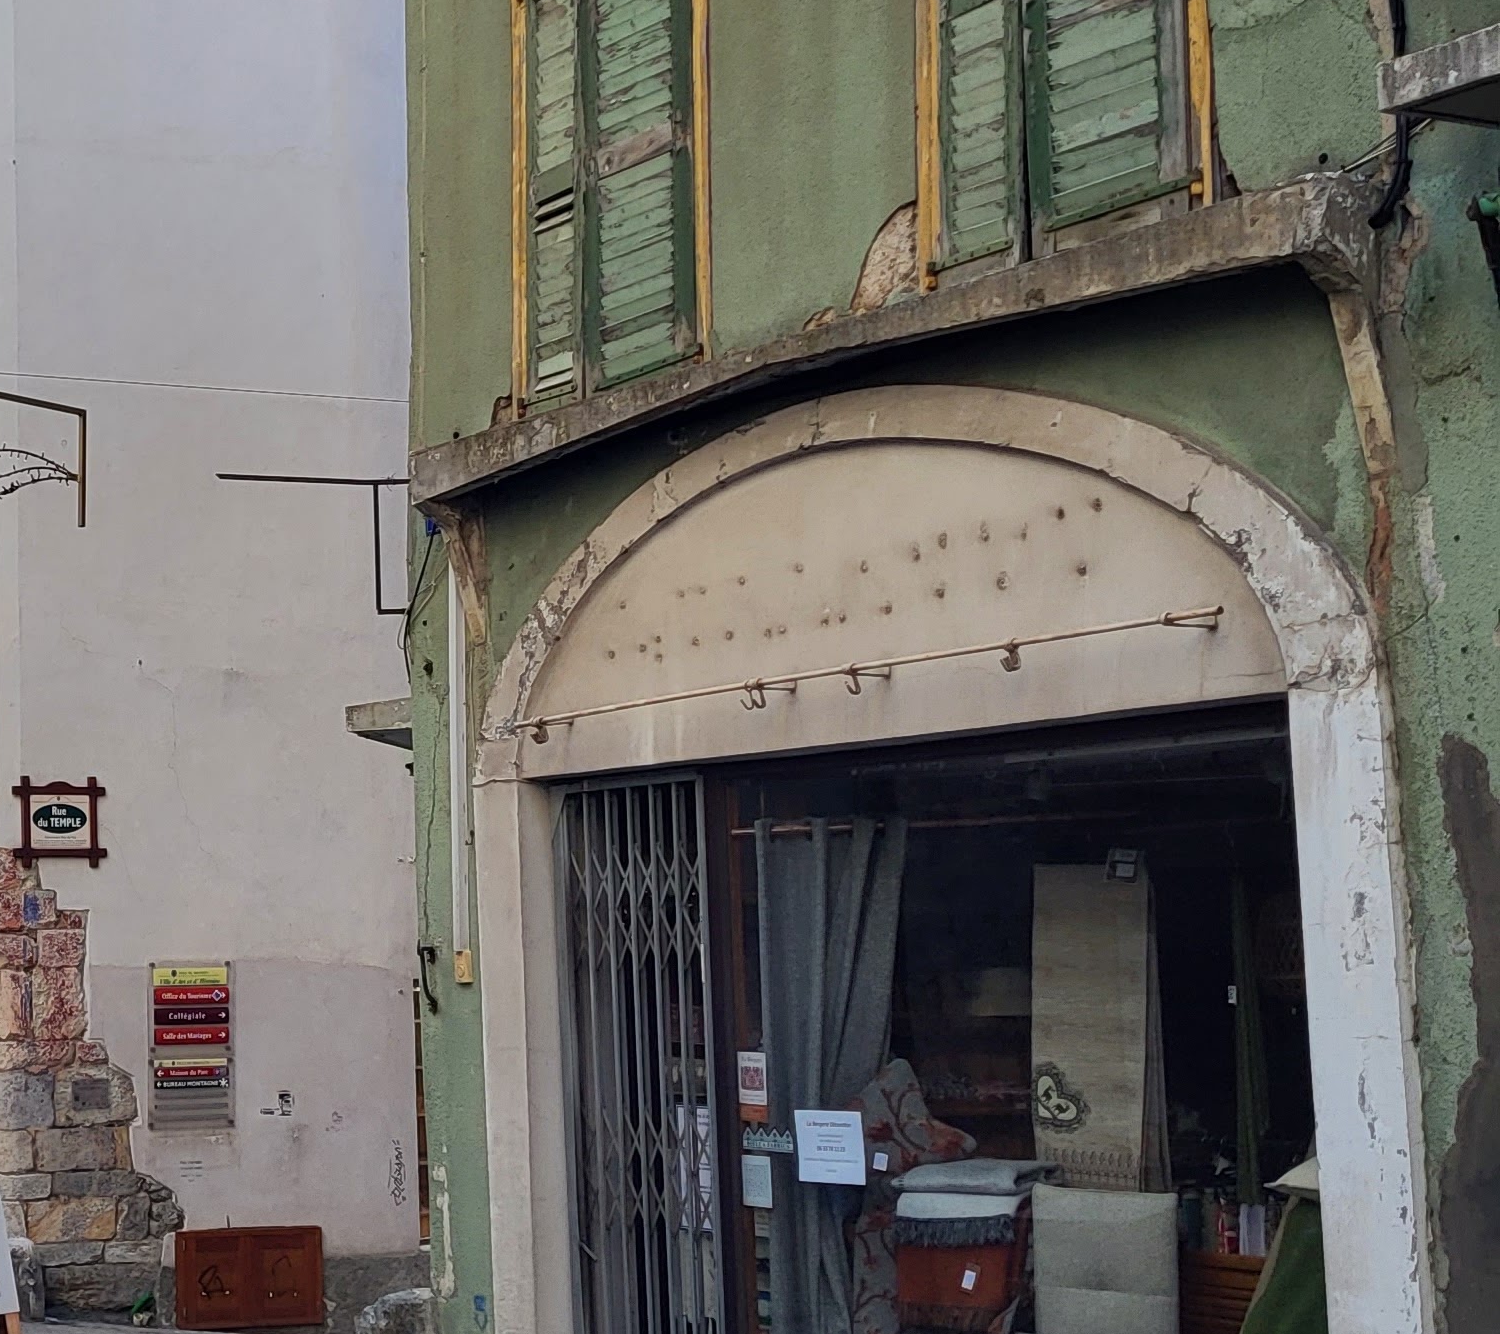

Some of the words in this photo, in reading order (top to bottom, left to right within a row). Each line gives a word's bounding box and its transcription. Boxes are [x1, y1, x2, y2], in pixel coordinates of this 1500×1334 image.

[51, 806, 67, 816] Rue
[37, 817, 48, 827] du
[49, 817, 82, 828] TEMPLE
[168, 1012, 206, 1020] Collégiale
